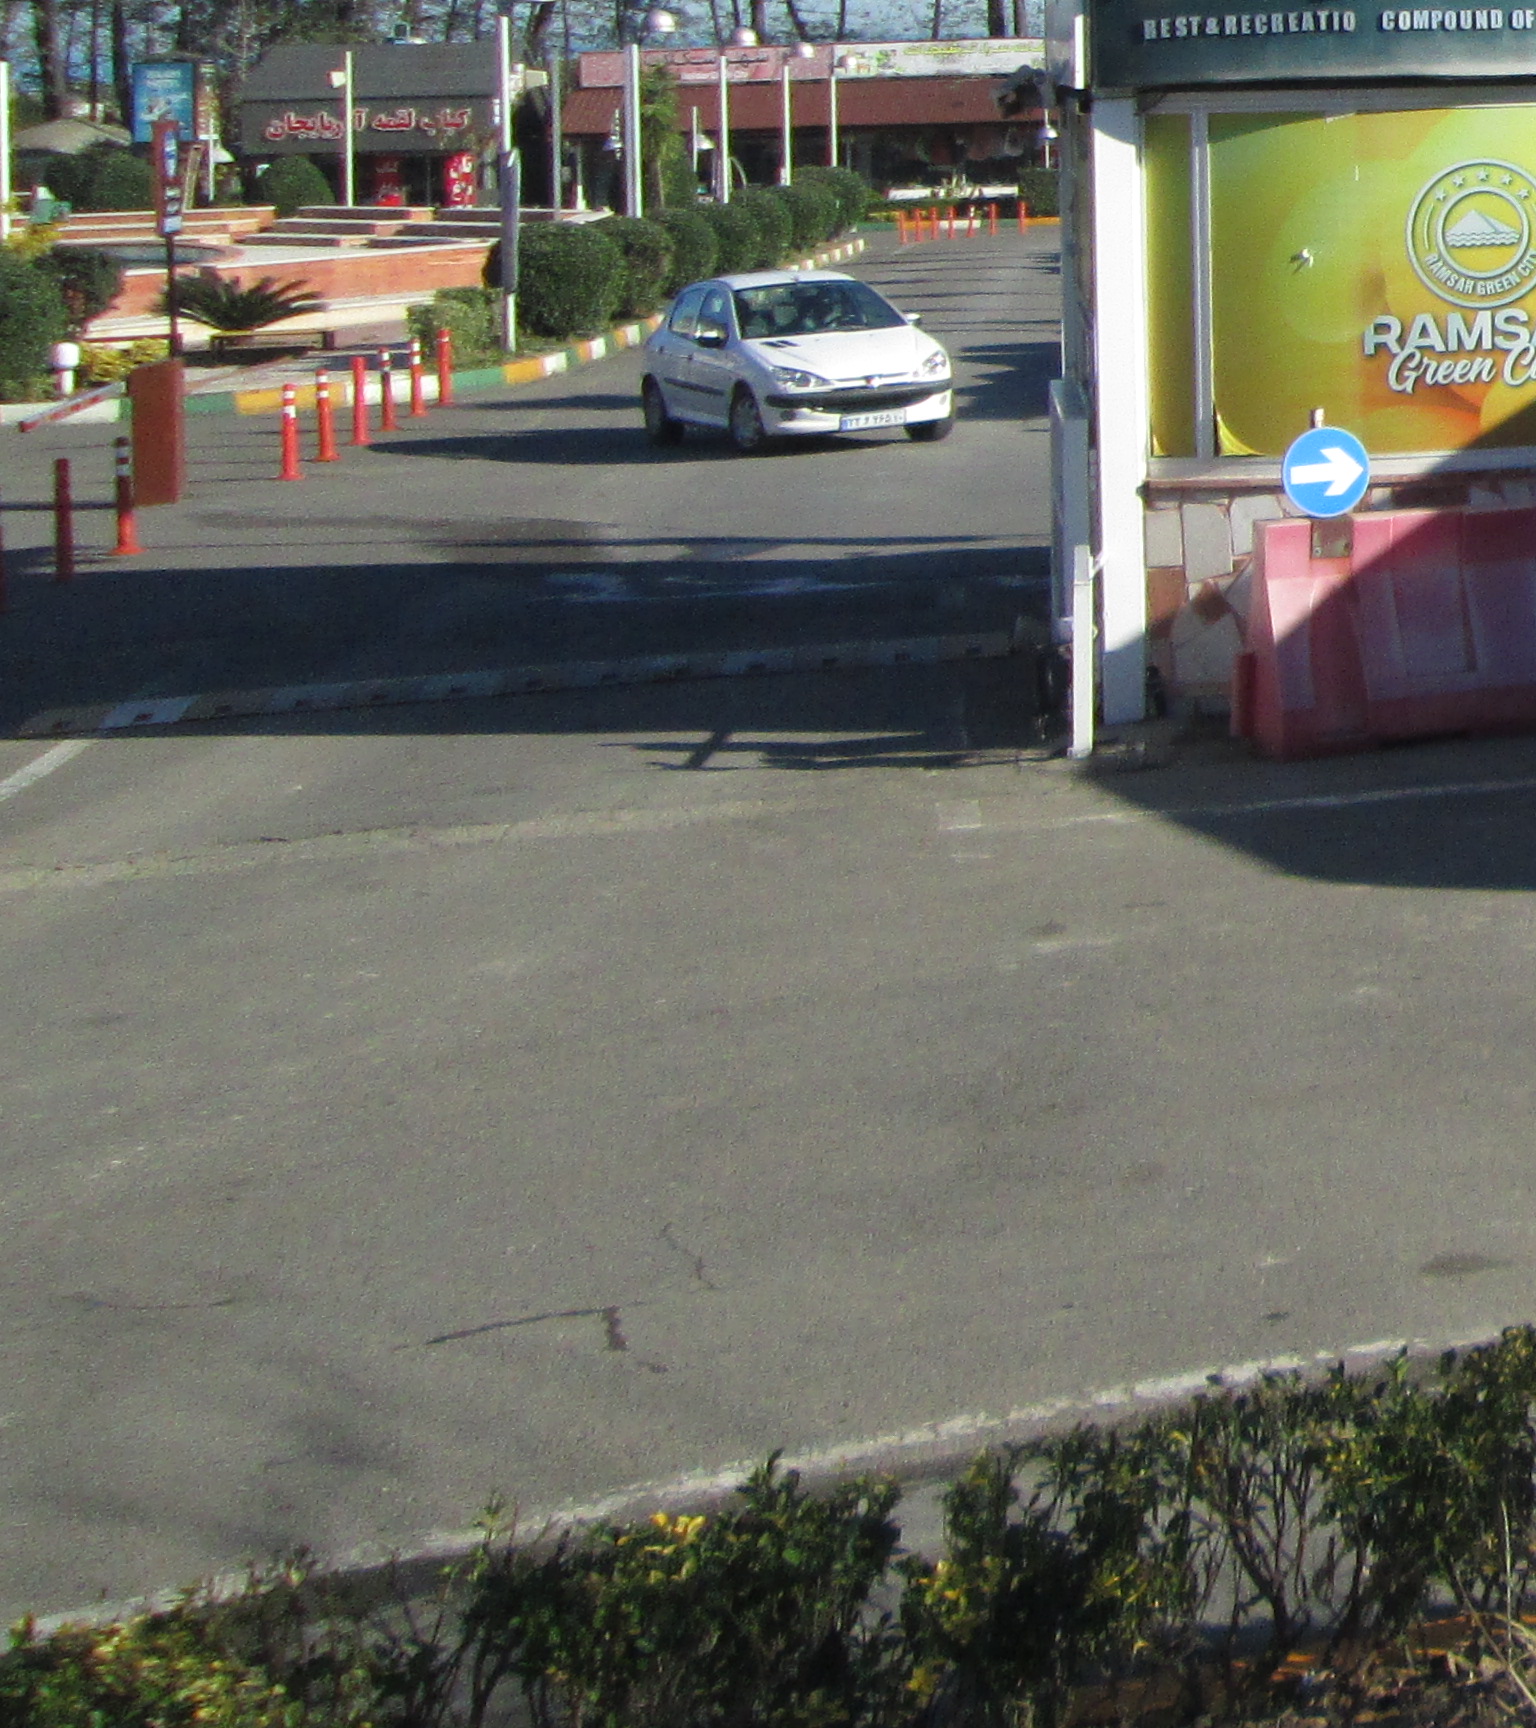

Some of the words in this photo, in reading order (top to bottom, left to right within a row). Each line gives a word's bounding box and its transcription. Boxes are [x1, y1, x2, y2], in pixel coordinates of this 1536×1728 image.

[1380, 9, 1503, 32] COMPOUND
[1511, 9, 1534, 31] OF
[1424, 253, 1474, 295] RAMSAR
[1477, 269, 1521, 296] GREEN
[1388, 347, 1496, 394] Green
